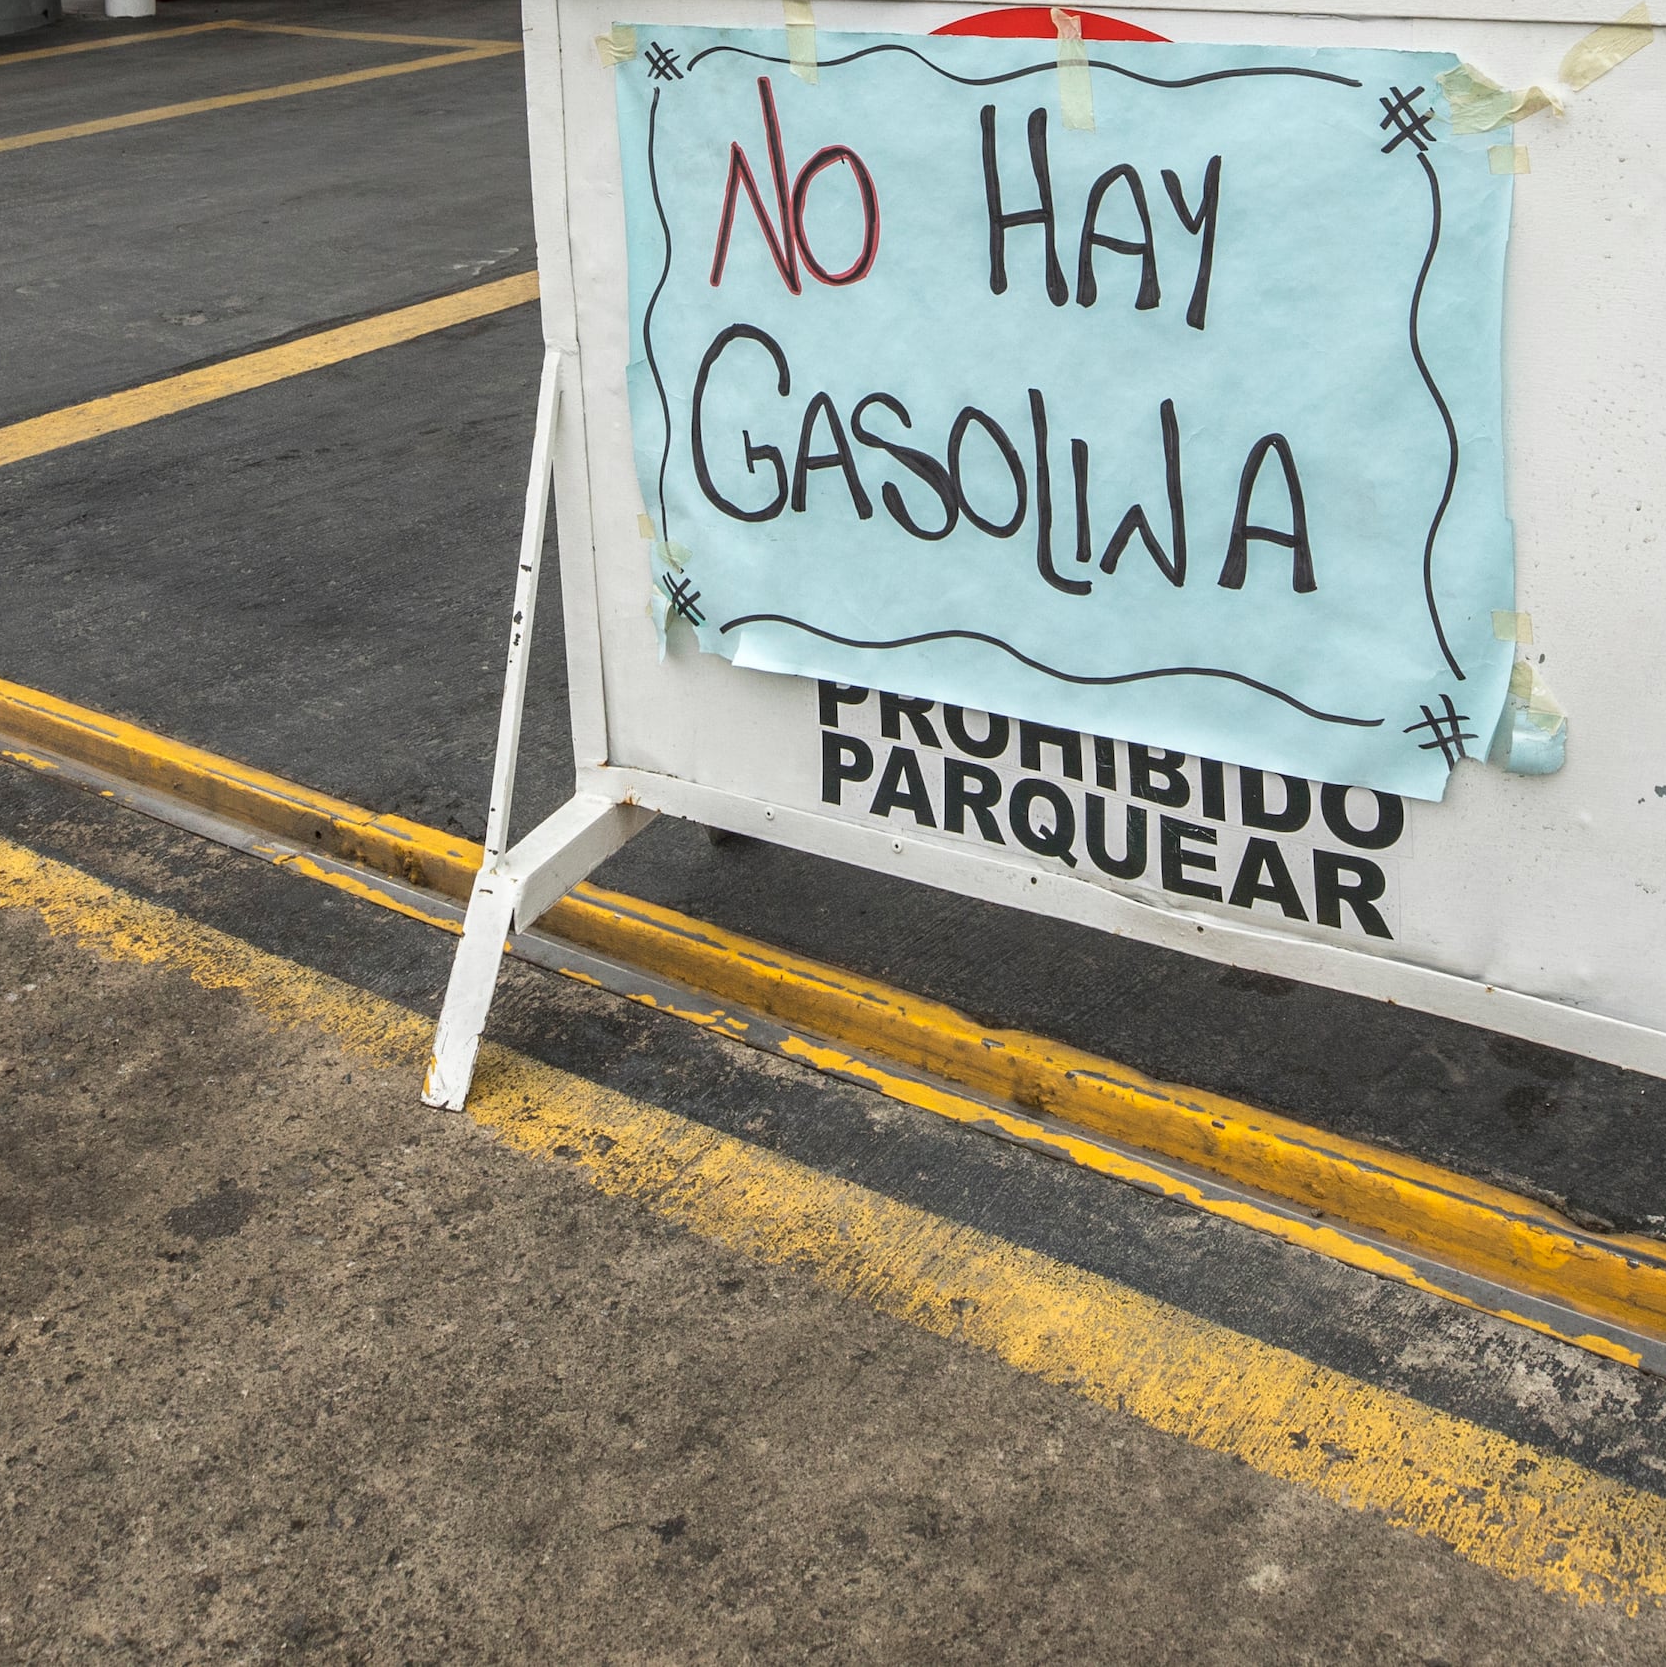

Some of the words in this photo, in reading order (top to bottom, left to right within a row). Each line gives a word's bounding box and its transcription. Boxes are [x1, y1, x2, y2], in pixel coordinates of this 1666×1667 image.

[709, 76, 881, 295] NO
[981, 104, 1222, 331] HAY
[691, 323, 1318, 596] GASOLINA
[817, 679, 1404, 851] PROHIBIDO
[821, 729, 1395, 941] PARQUEAR
